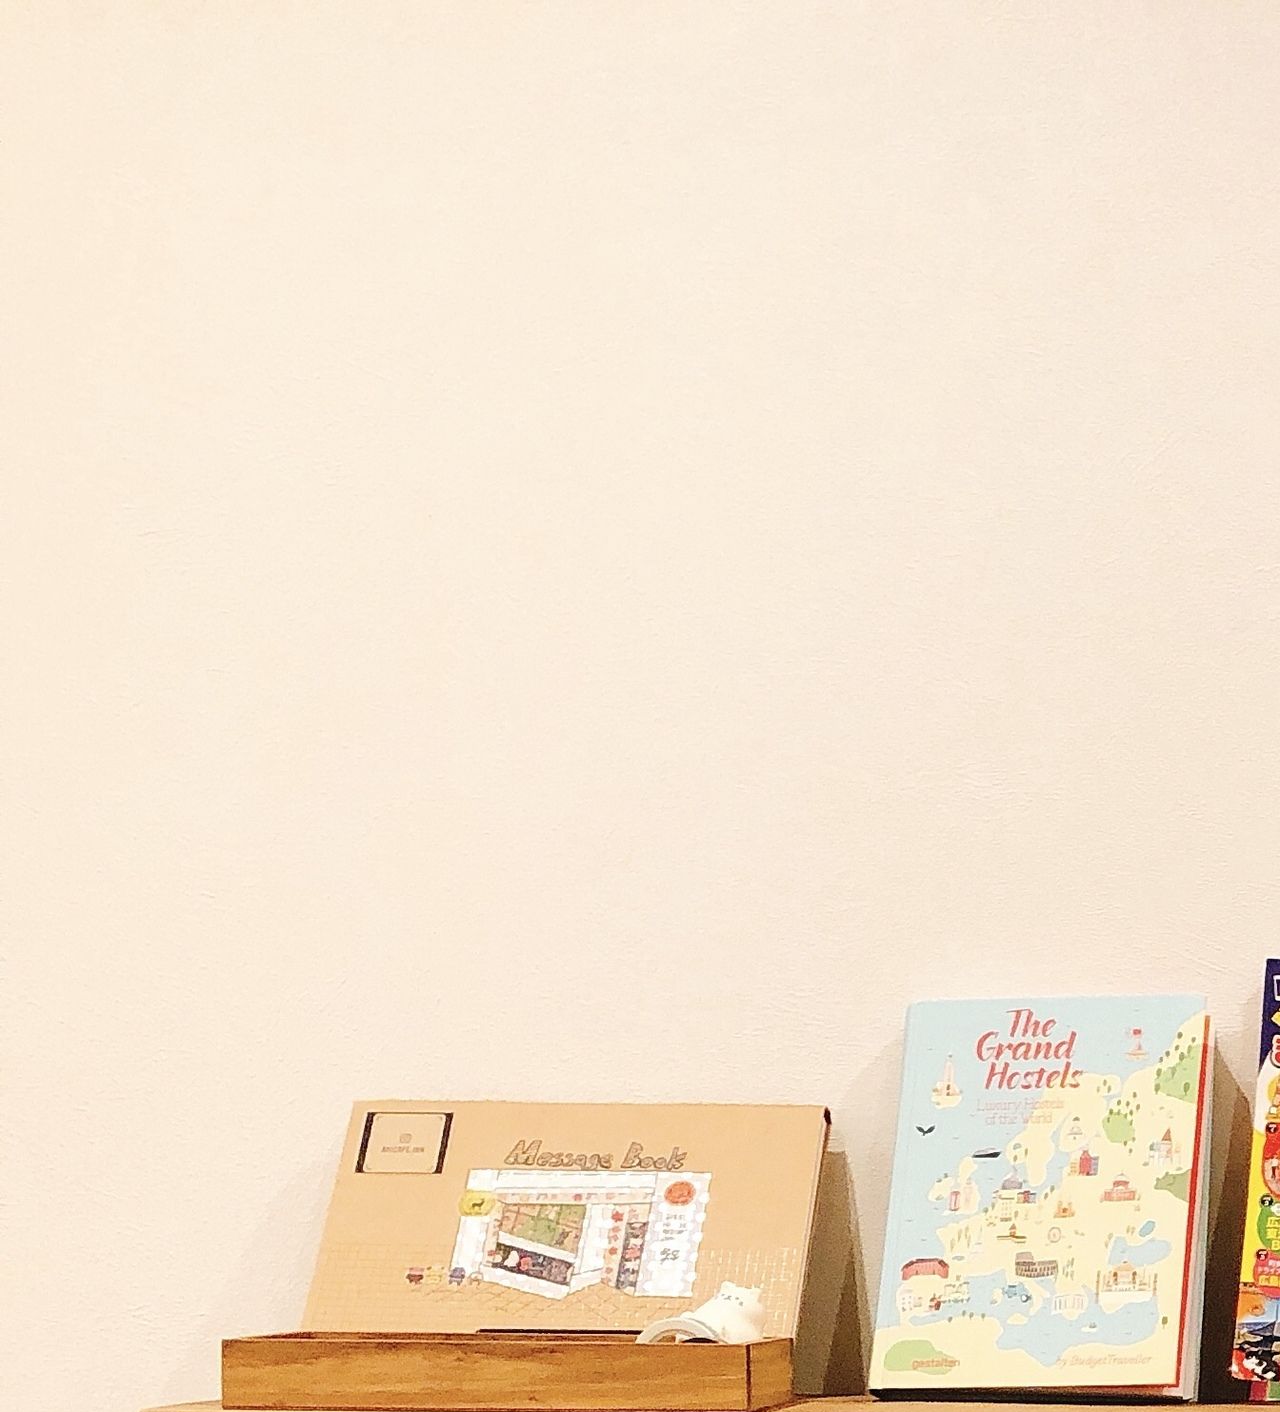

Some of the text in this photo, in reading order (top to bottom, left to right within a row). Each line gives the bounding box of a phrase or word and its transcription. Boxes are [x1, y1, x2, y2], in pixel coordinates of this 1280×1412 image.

[1006, 1008, 1057, 1037] The
[976, 1031, 1077, 1062] Grand
[985, 1061, 1083, 1090] Hostels
[504, 1140, 688, 1169] Message Book
[912, 1358, 960, 1370] gestalten
